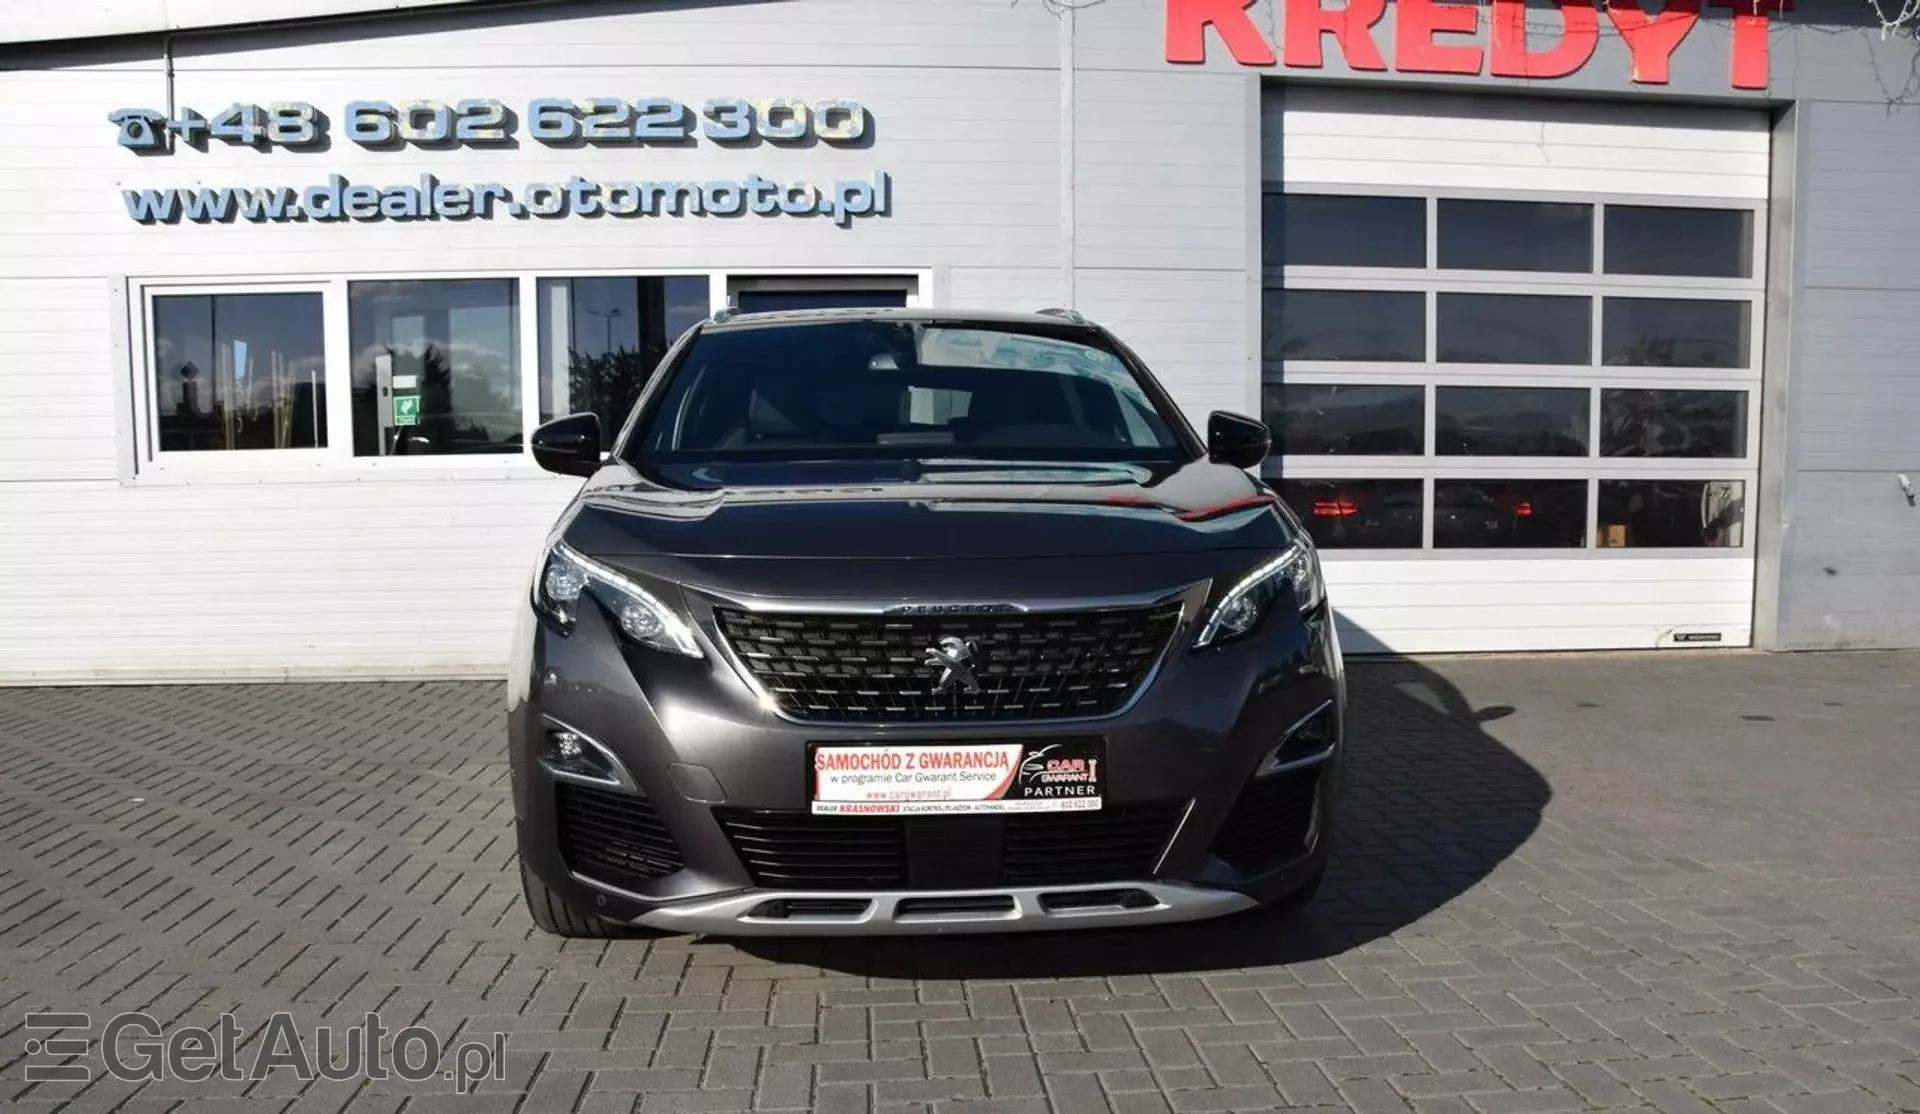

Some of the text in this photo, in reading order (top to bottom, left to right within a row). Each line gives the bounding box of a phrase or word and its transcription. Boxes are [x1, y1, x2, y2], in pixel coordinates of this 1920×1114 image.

[1165, 0, 1796, 90] KREDYT
[167, 97, 866, 146] +48 602 622 300
[121, 169, 889, 224] www.dealer.otomoto.pl
[815, 748, 1010, 771] SAMOCHÓD Z GWARANCJĄ
[1046, 759, 1085, 771] CAR
[830, 771, 997, 785] w programie Car Gwarant Service
[1024, 785, 1096, 797] PARTNER
